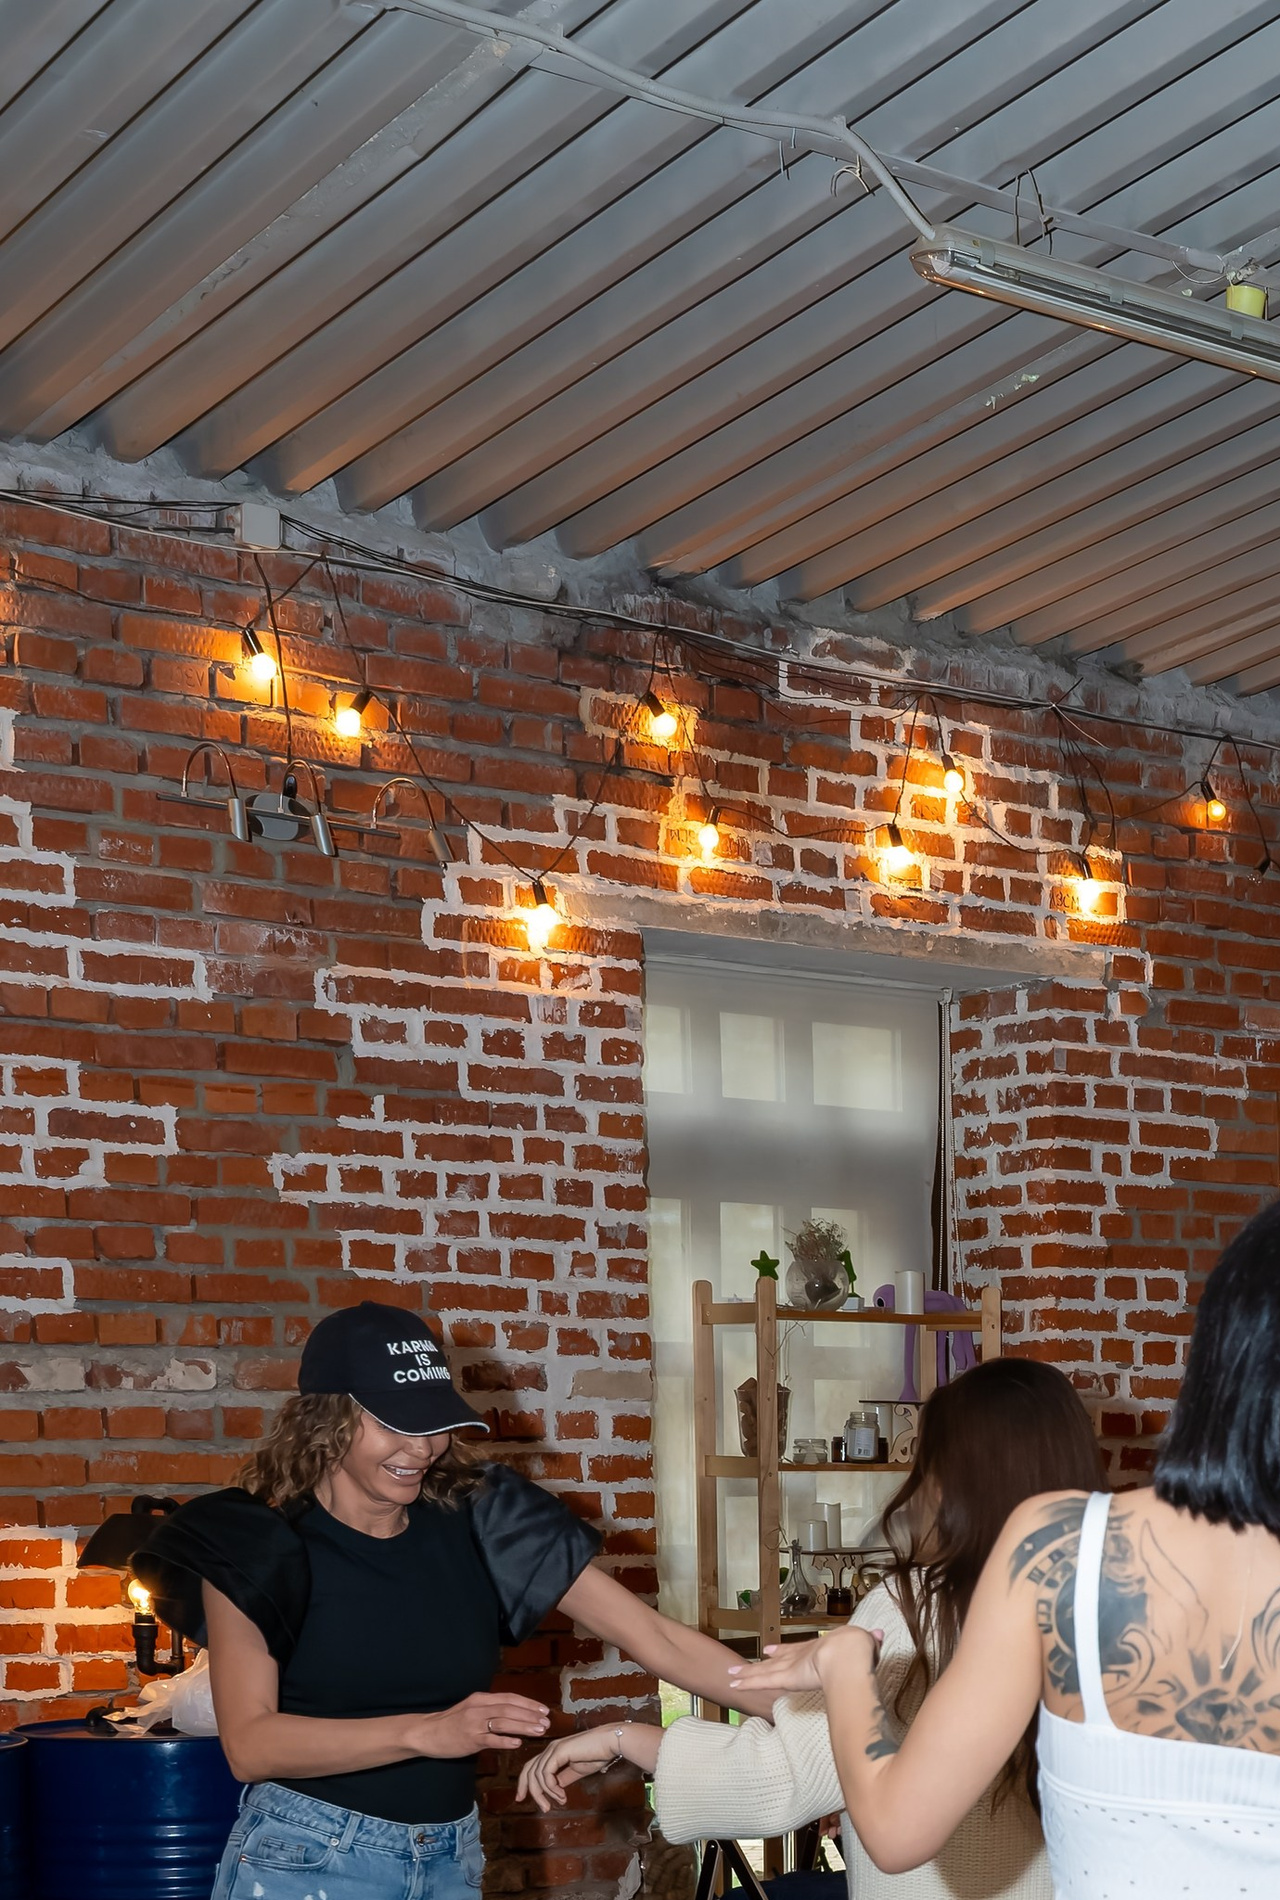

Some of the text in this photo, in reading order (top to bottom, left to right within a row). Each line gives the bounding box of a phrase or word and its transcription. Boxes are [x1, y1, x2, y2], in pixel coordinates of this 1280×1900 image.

[387, 1339, 439, 1356] KARMA
[414, 1353, 431, 1366] IS
[393, 1366, 451, 1384] COMING
